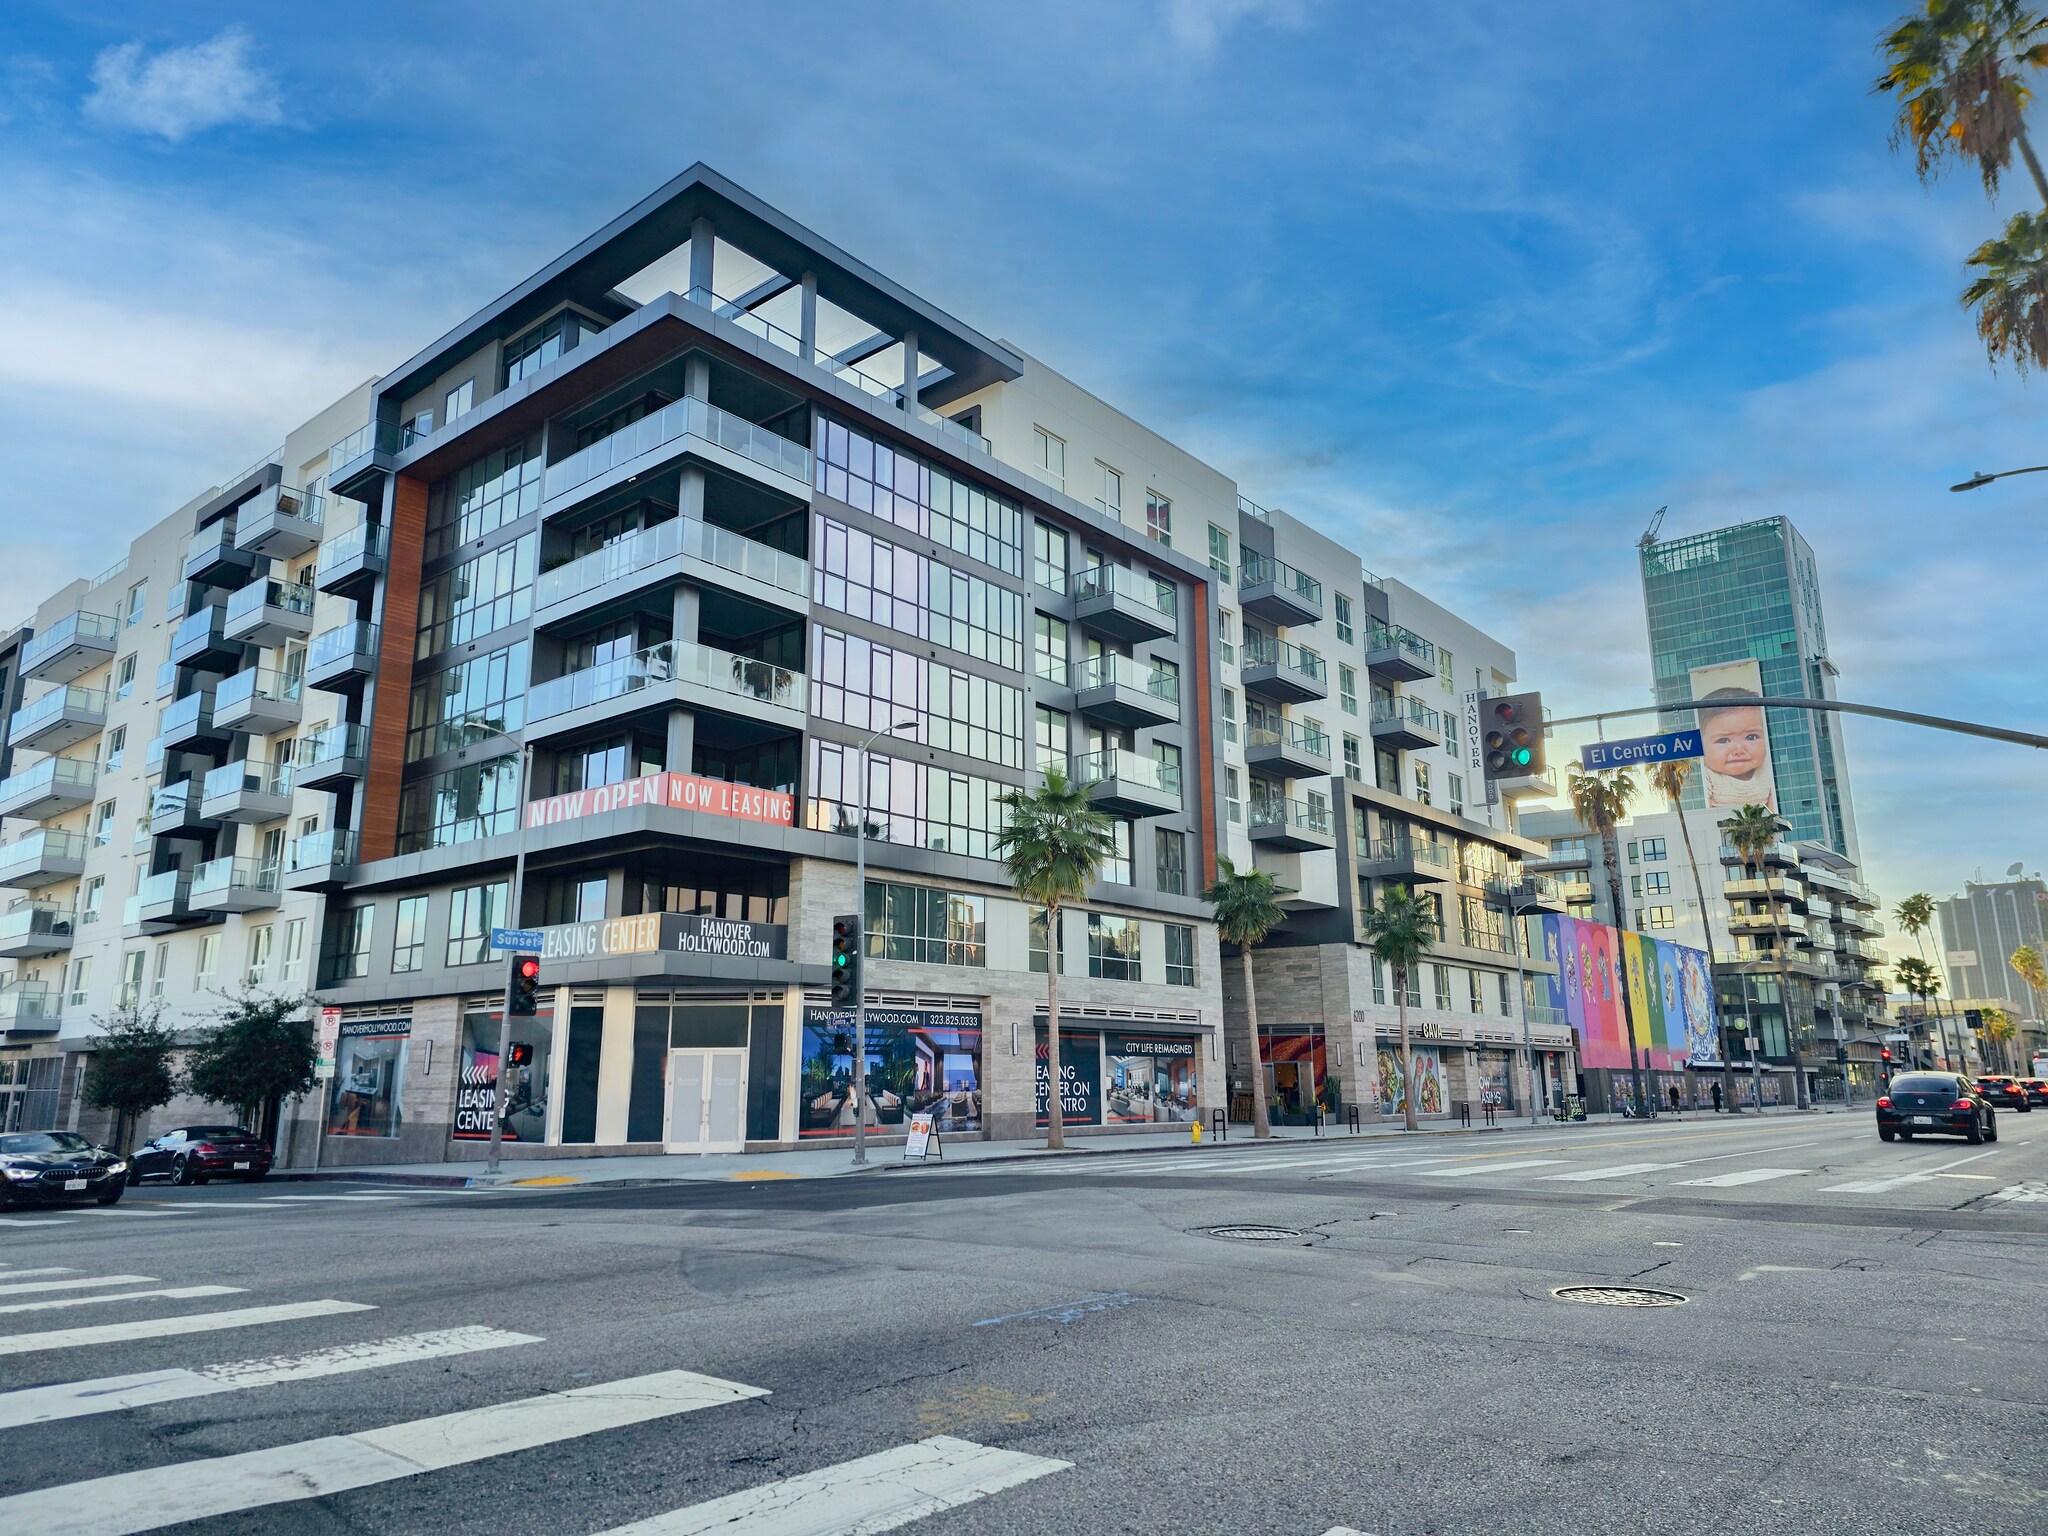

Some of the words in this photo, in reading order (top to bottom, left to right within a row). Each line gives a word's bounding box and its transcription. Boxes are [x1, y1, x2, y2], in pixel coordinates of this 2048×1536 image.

[1466, 693, 1481, 768] HANOVER
[1590, 747, 1606, 763] El
[1612, 743, 1667, 760] Centro
[1673, 738, 1692, 752] Av
[530, 791, 586, 828] NOW
[671, 779, 712, 807] NOW
[721, 789, 792, 821] LEASING
[602, 917, 656, 953] CENTER
[700, 918, 751, 940] HANOVER
[497, 933, 538, 947] Sunset
[678, 932, 770, 957] HOLLYWOOD.COM
[342, 1021, 411, 1035] HANOVERHOLLYWOOD.COM
[929, 1014, 978, 1026] 323.825.0333
[1126, 1042, 1140, 1053] CITY
[1141, 1043, 1153, 1053] LIFE
[1154, 1043, 1193, 1054] REIMAGINED
[1036, 1065, 1076, 1080] EANG
[1072, 1081, 1090, 1096] ON
[457, 1110, 495, 1130] CENTE
